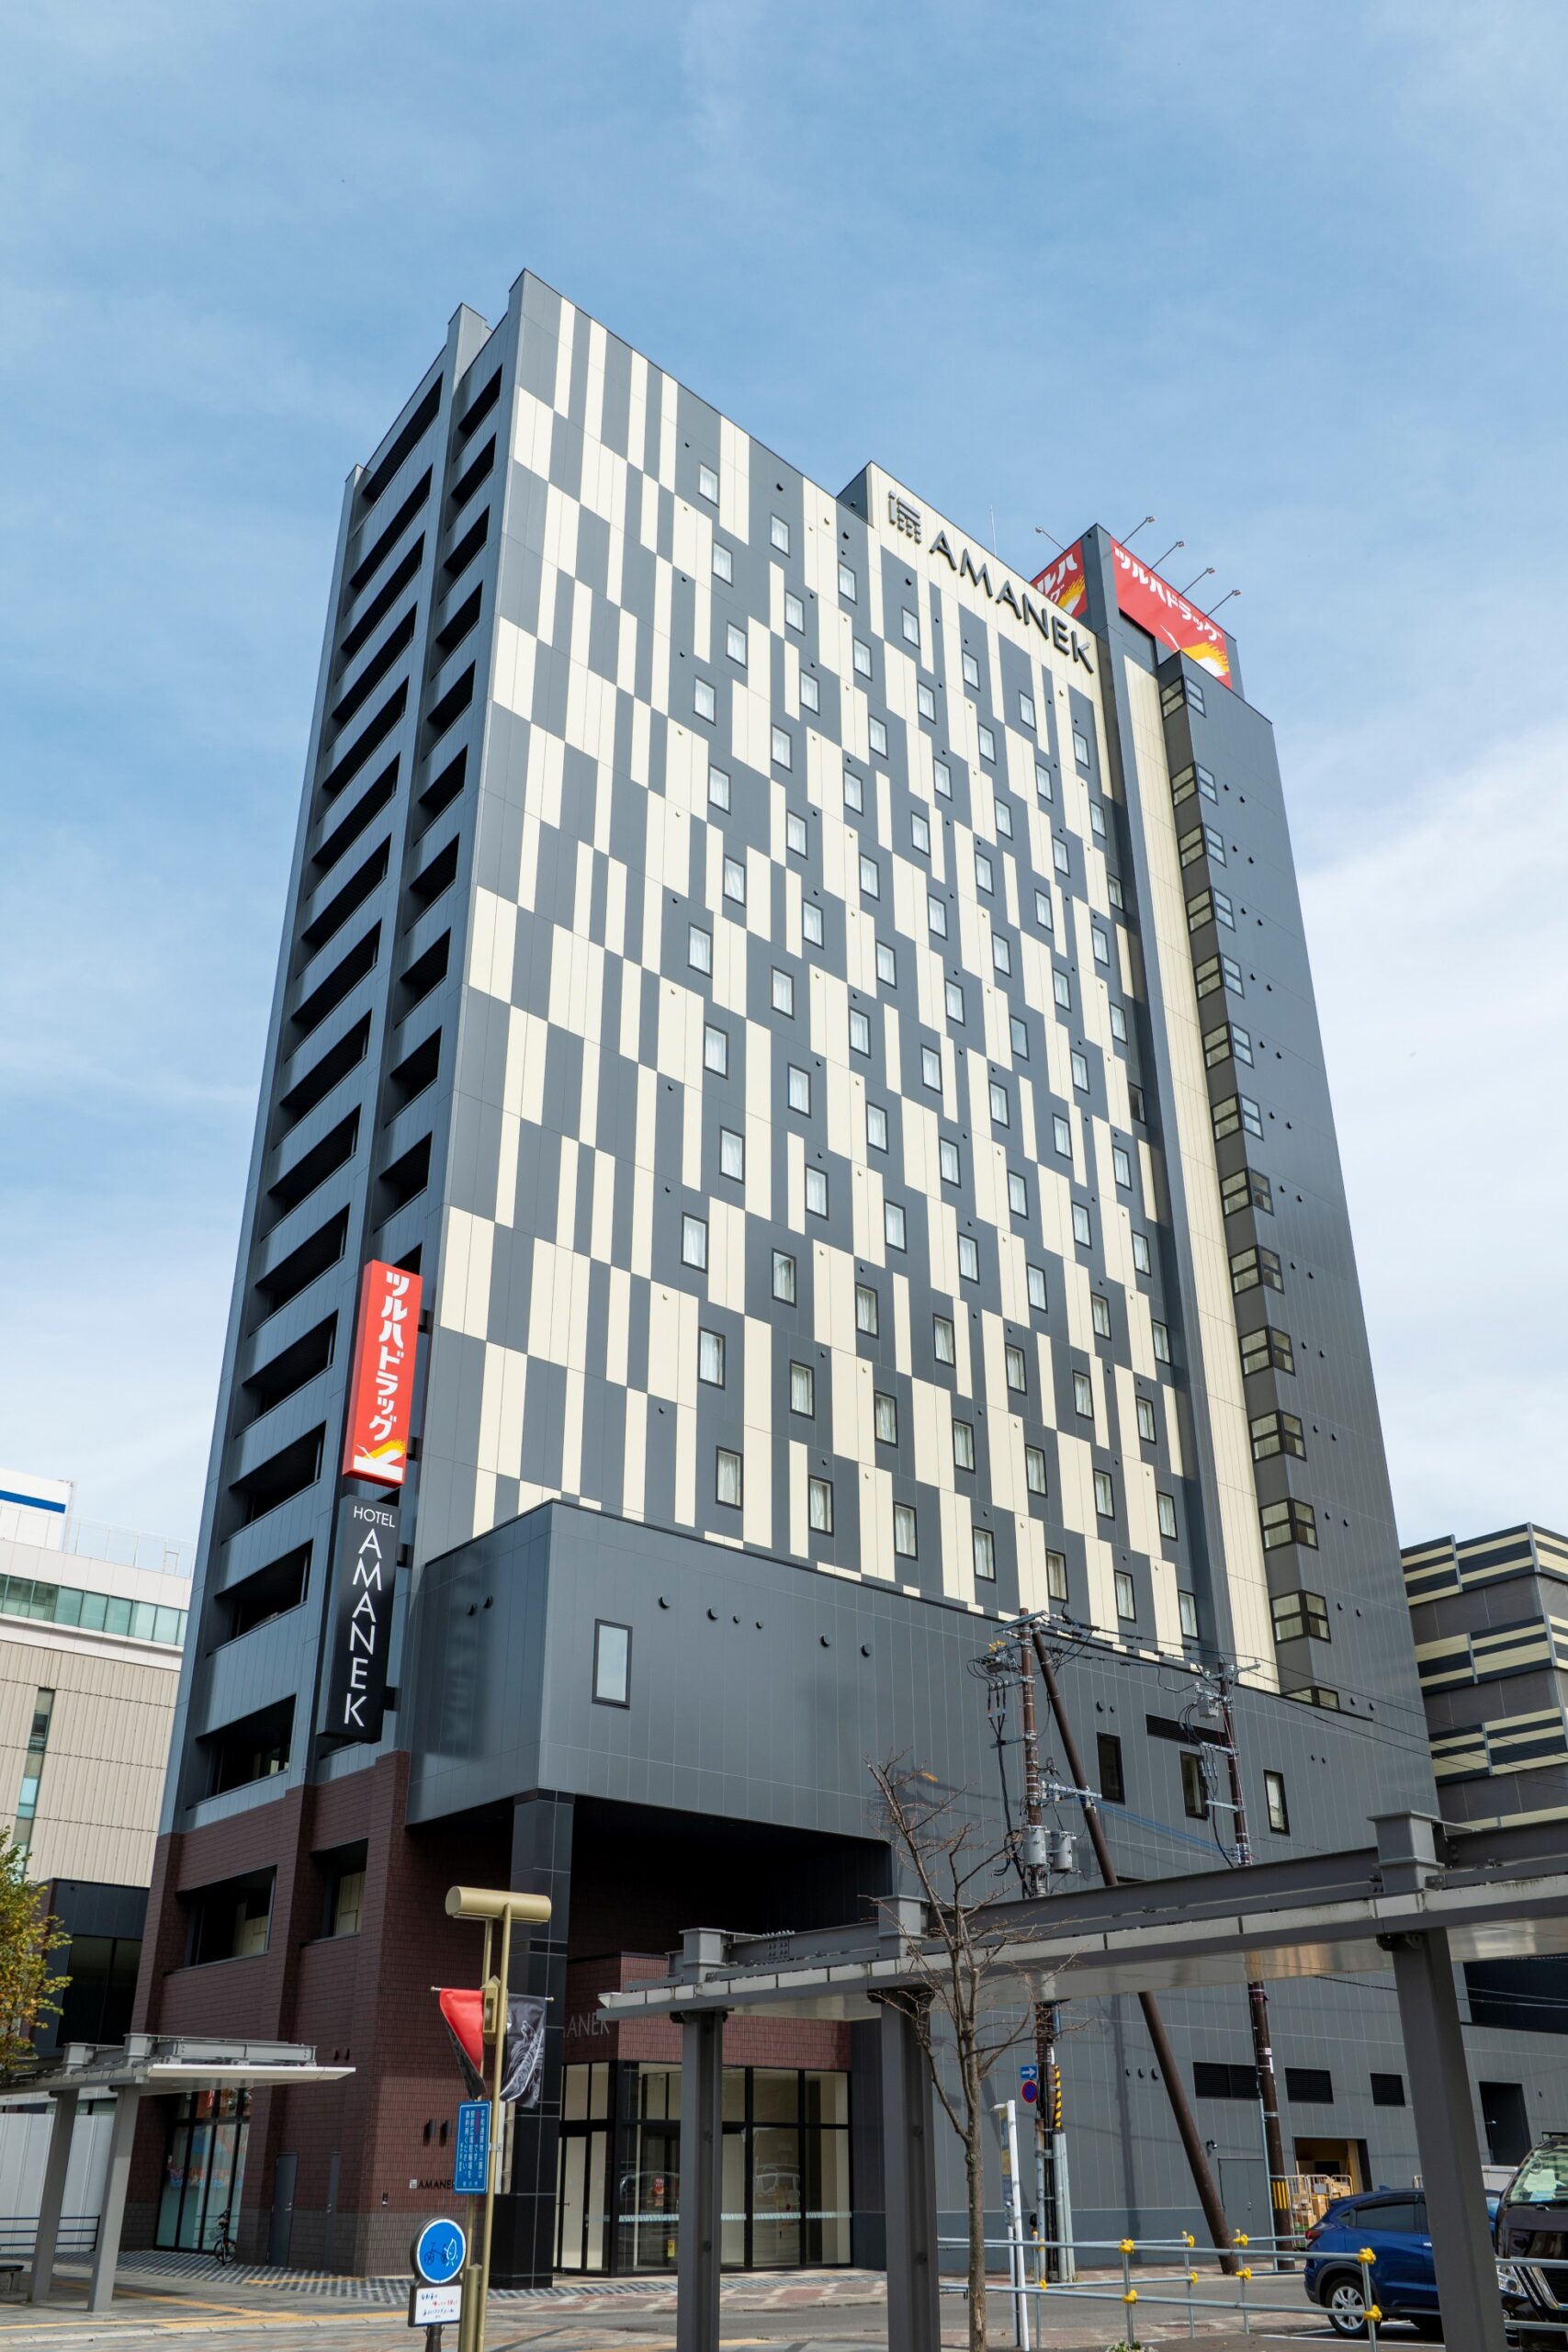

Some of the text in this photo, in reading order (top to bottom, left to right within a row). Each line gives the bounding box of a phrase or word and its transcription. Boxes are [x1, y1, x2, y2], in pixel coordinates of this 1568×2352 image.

[929, 529, 1095, 674] AMANEK
[1036, 552, 1078, 596] ルハ
[1113, 546, 1223, 641] ツルハドラッグ
[369, 1271, 411, 1442] ツルハドラッグ
[353, 1505, 396, 1528] HOTEL
[344, 1528, 382, 1727] AMANEK
[563, 2012, 610, 2038] ANEK
